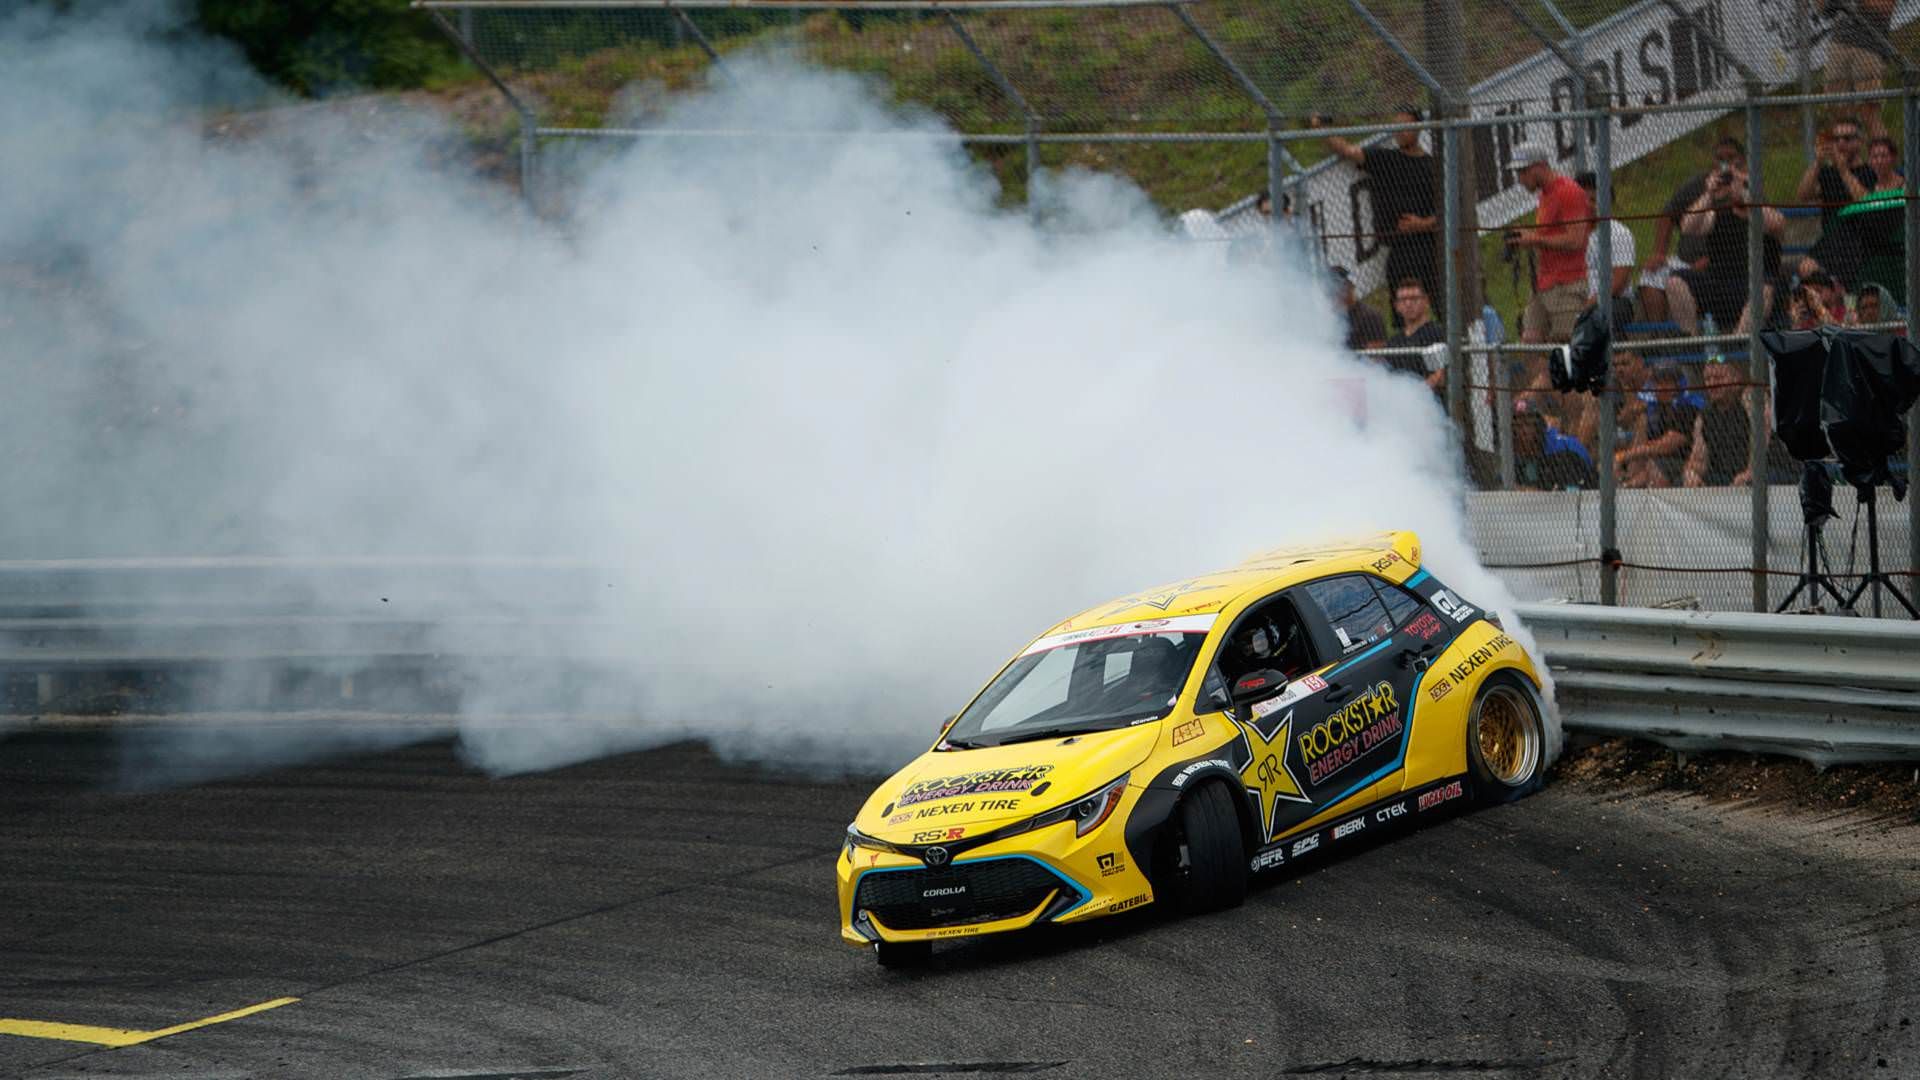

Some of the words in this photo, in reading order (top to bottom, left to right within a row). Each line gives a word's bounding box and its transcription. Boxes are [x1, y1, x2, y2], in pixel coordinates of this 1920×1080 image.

[1403, 613, 1437, 637] TOYOTA
[1449, 646, 1493, 685] NEXEN
[1303, 674, 1326, 691] 151
[1310, 736, 1360, 782] ENERGY
[1362, 713, 1402, 751] DRINK
[898, 785, 970, 807] ENERGY
[975, 779, 1033, 792] DRINK
[1444, 780, 1462, 800] OIL
[916, 802, 975, 819] NEXEN
[979, 799, 1020, 811] TIRE
[1376, 802, 1407, 822] CTEK
[1340, 816, 1366, 838] BERK
[1260, 848, 1283, 866] EFR
[923, 886, 966, 897] COROLLA
[1109, 893, 1148, 912] GATEBIL
